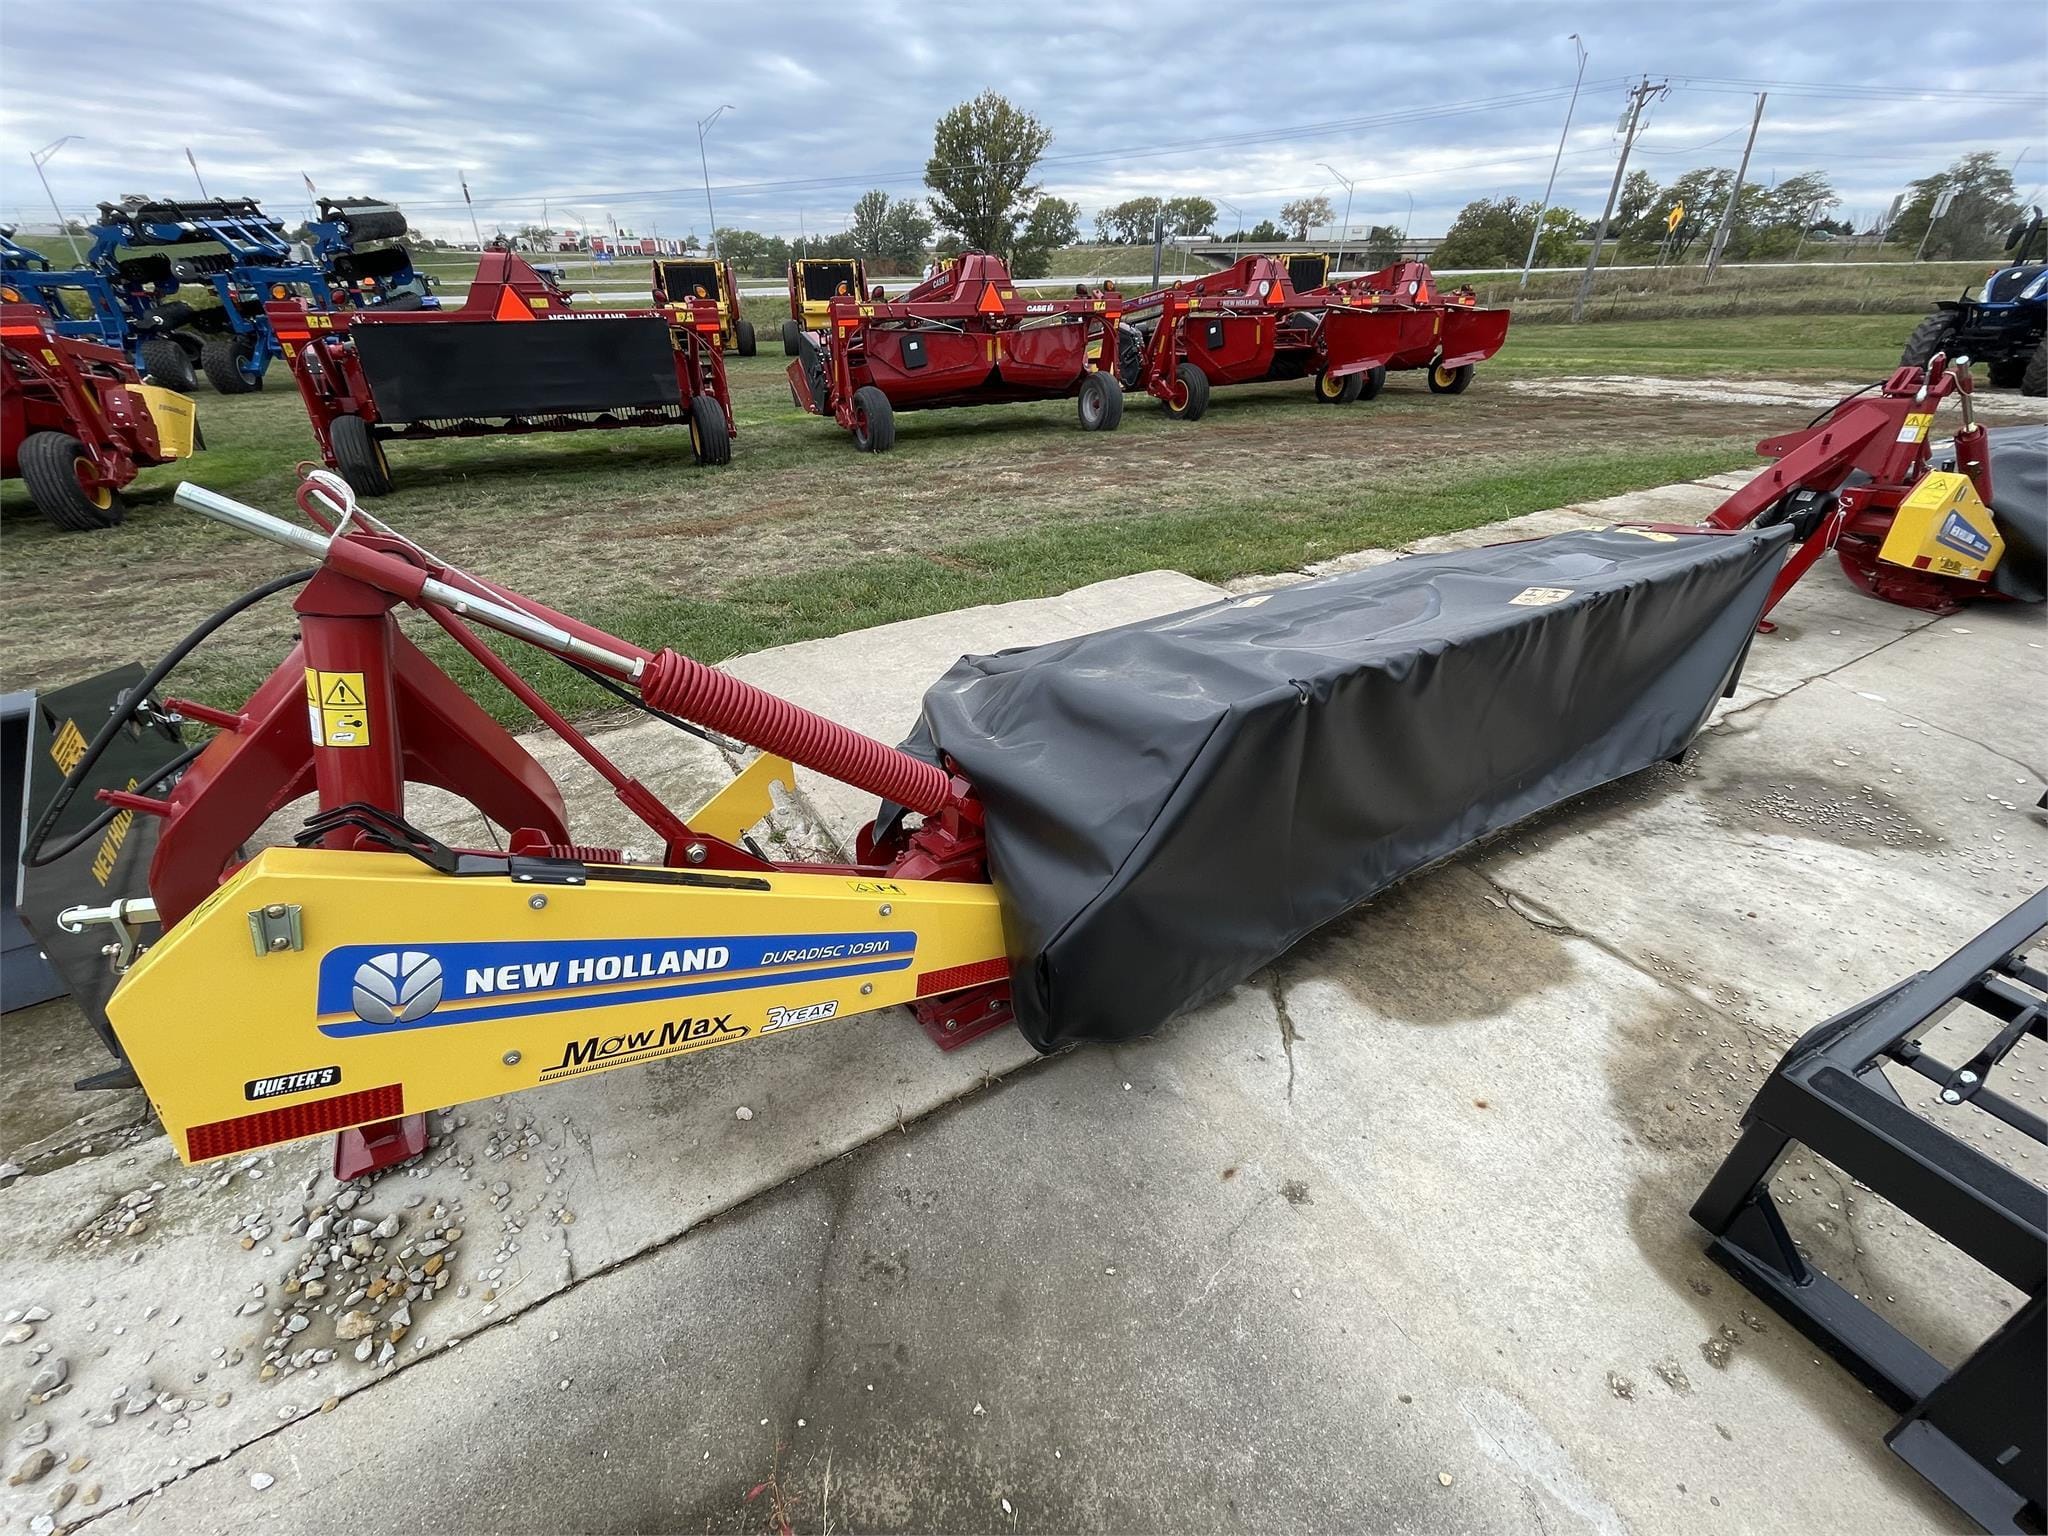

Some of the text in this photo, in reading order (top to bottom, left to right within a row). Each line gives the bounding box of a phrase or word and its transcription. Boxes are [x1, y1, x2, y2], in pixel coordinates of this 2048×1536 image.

[1026, 304, 1047, 312] CASE
[92, 837, 118, 888] NEW
[760, 939, 890, 965] DURADISC 109M
[465, 946, 730, 994] NEW HOLLAND
[659, 1014, 733, 1046] Max
[252, 1068, 334, 1098] RUETER'S
